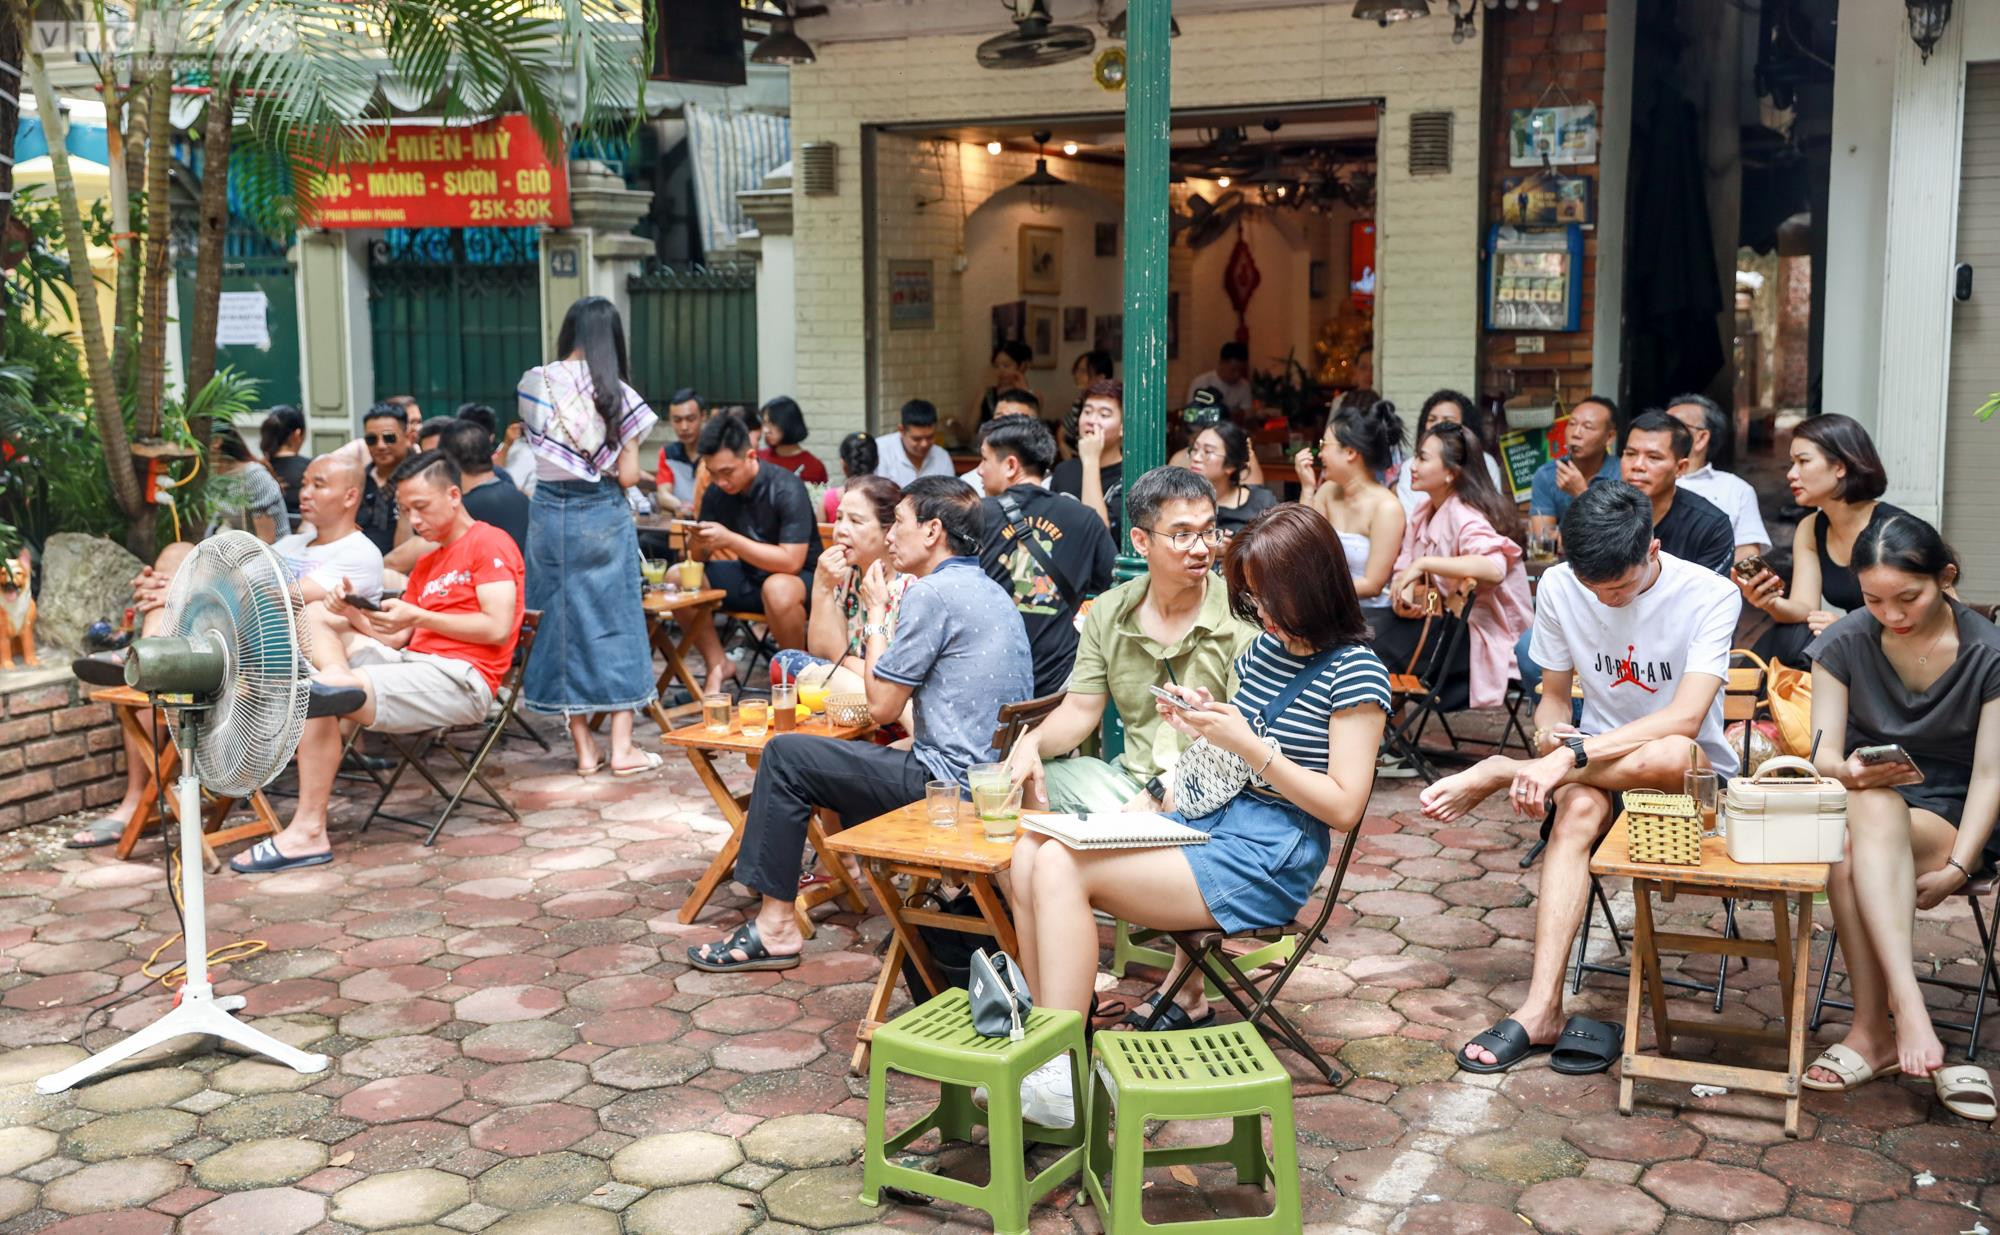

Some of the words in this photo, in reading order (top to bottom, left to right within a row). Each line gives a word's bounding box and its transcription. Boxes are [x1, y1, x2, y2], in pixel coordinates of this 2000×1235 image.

[469, 198, 553, 220] 25K-30K
[552, 255, 574, 273] 42
[1036, 516, 1063, 541] LIFE!
